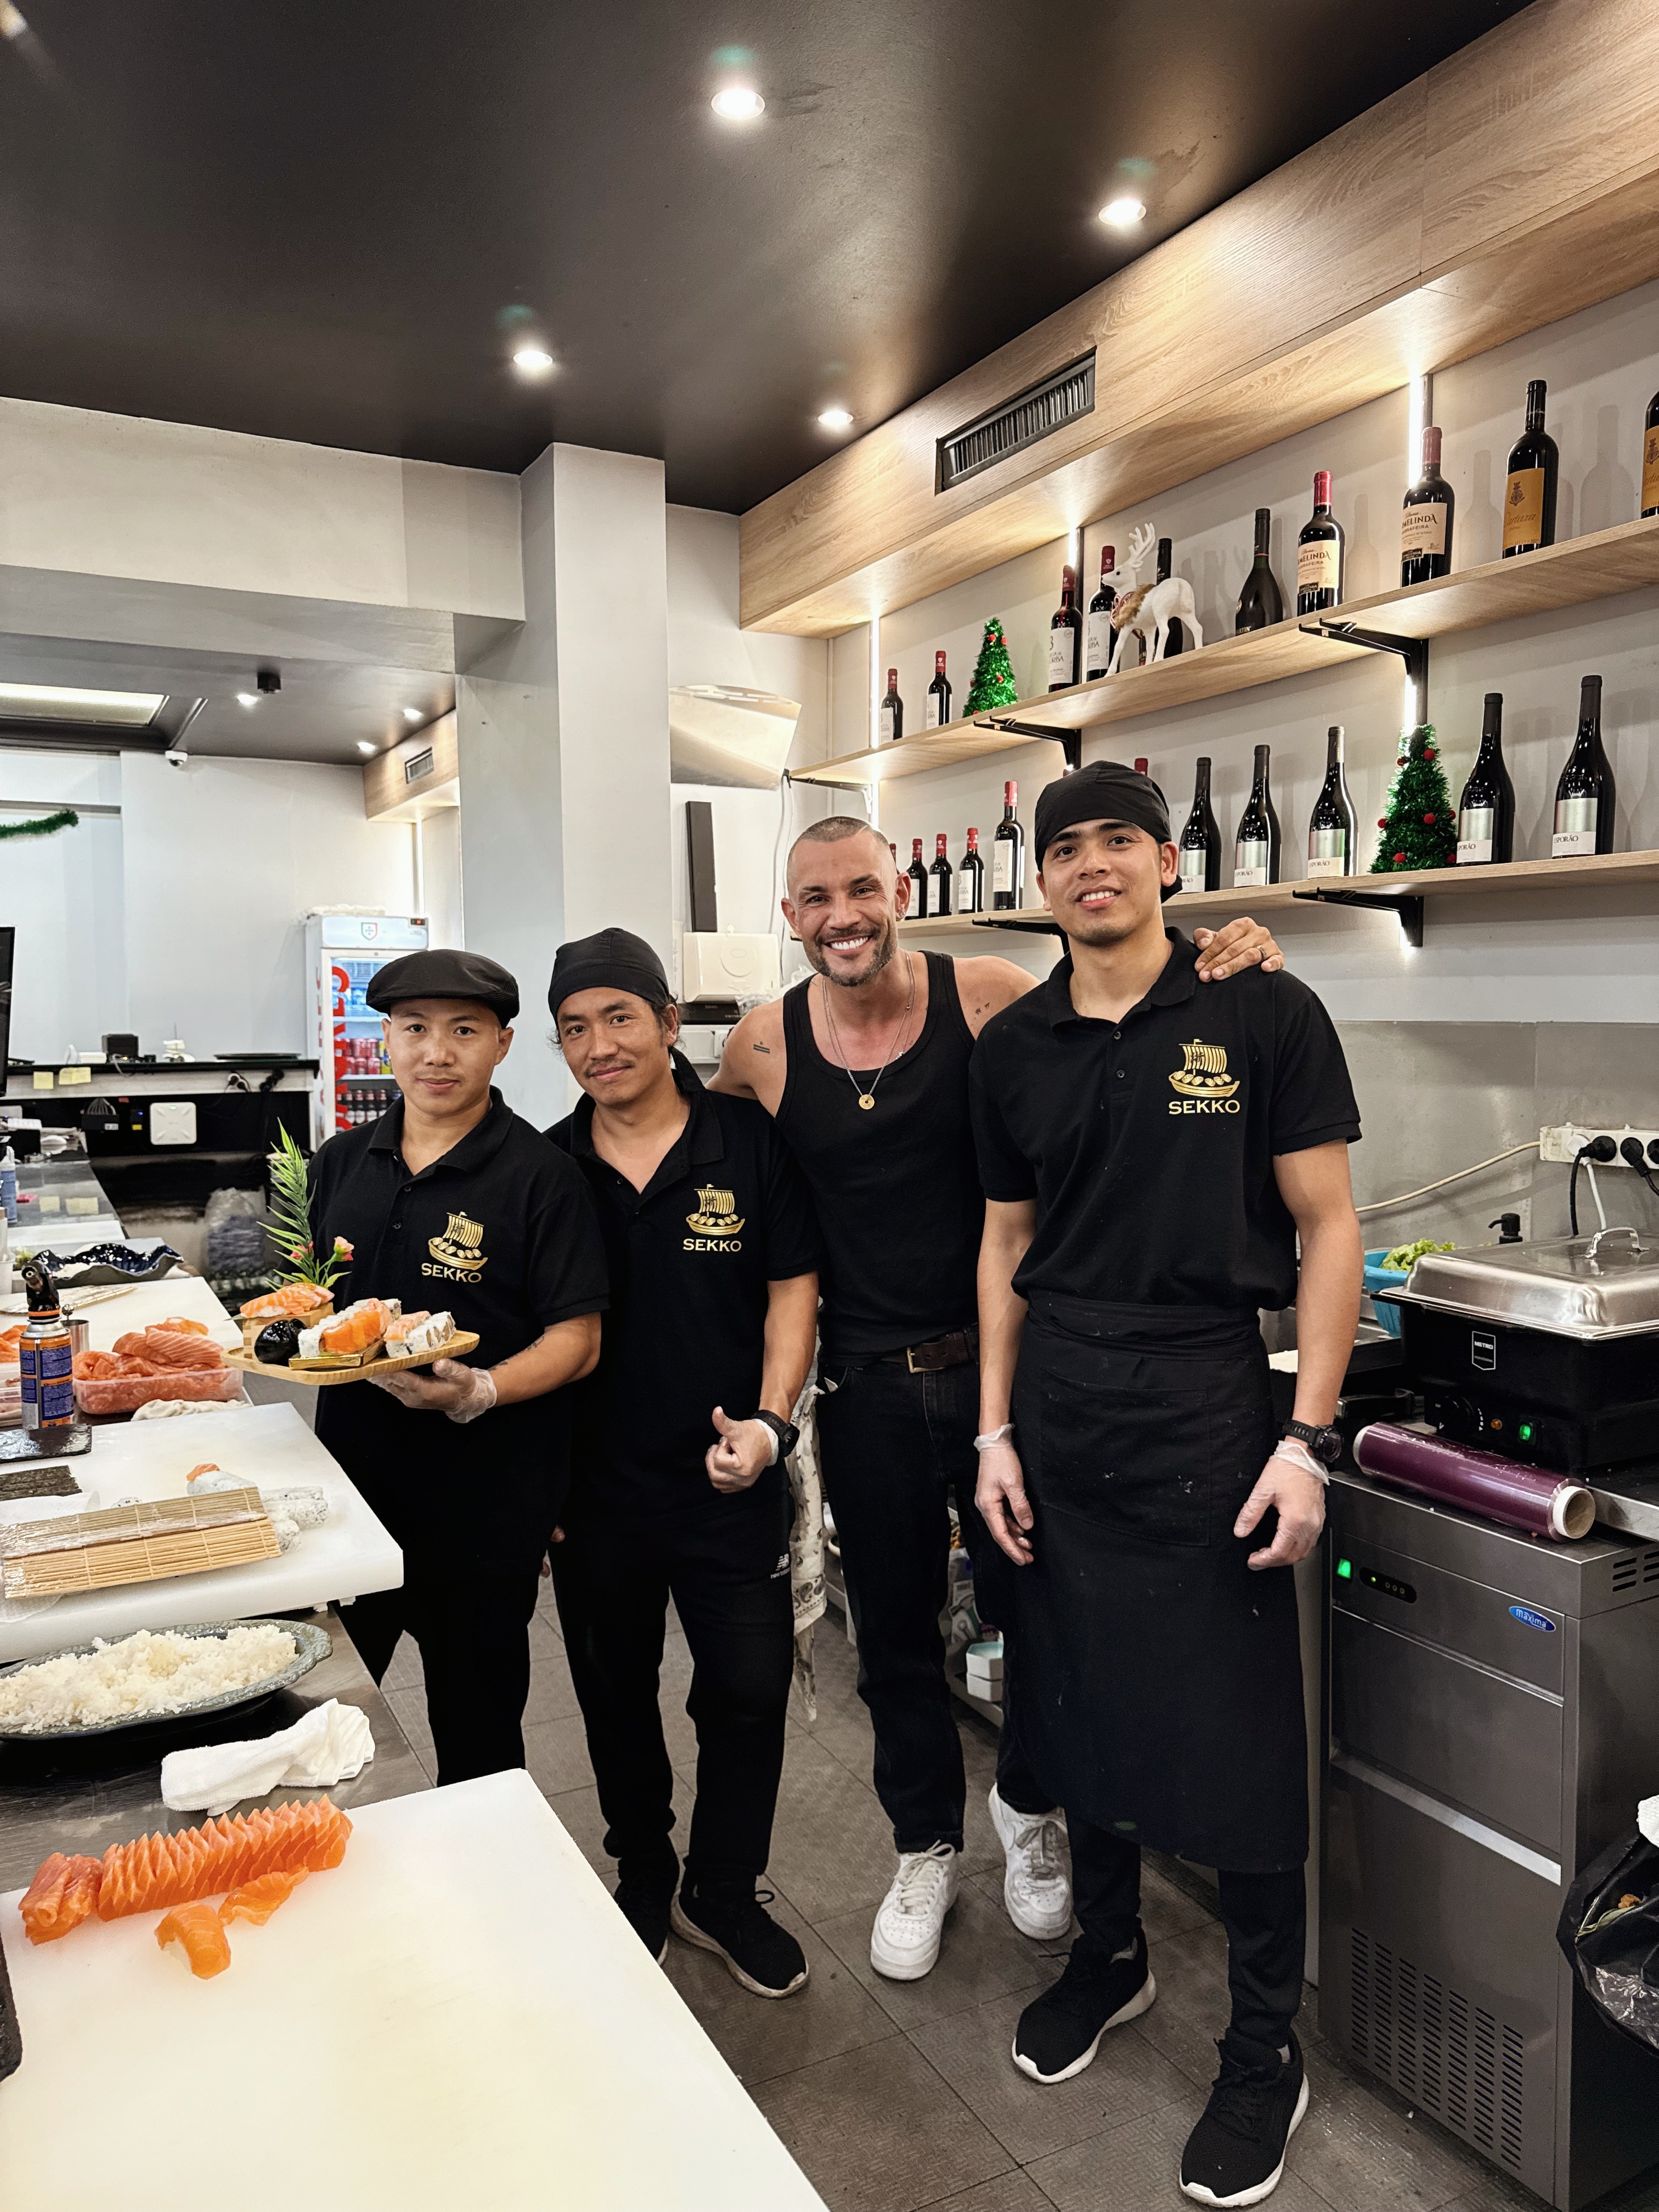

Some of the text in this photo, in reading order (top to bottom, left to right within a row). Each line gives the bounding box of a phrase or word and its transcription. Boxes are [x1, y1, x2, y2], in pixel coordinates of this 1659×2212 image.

[1402, 514, 1438, 528] MELINDA
[1298, 551, 1331, 565] MELINDA
[1169, 1099, 1240, 1115] SEKKO
[682, 1238, 742, 1252] SEKKO
[421, 1262, 482, 1283] SEKKO
[1474, 1341, 1494, 1350] METRO
[1516, 1609, 1547, 1628] maxima
